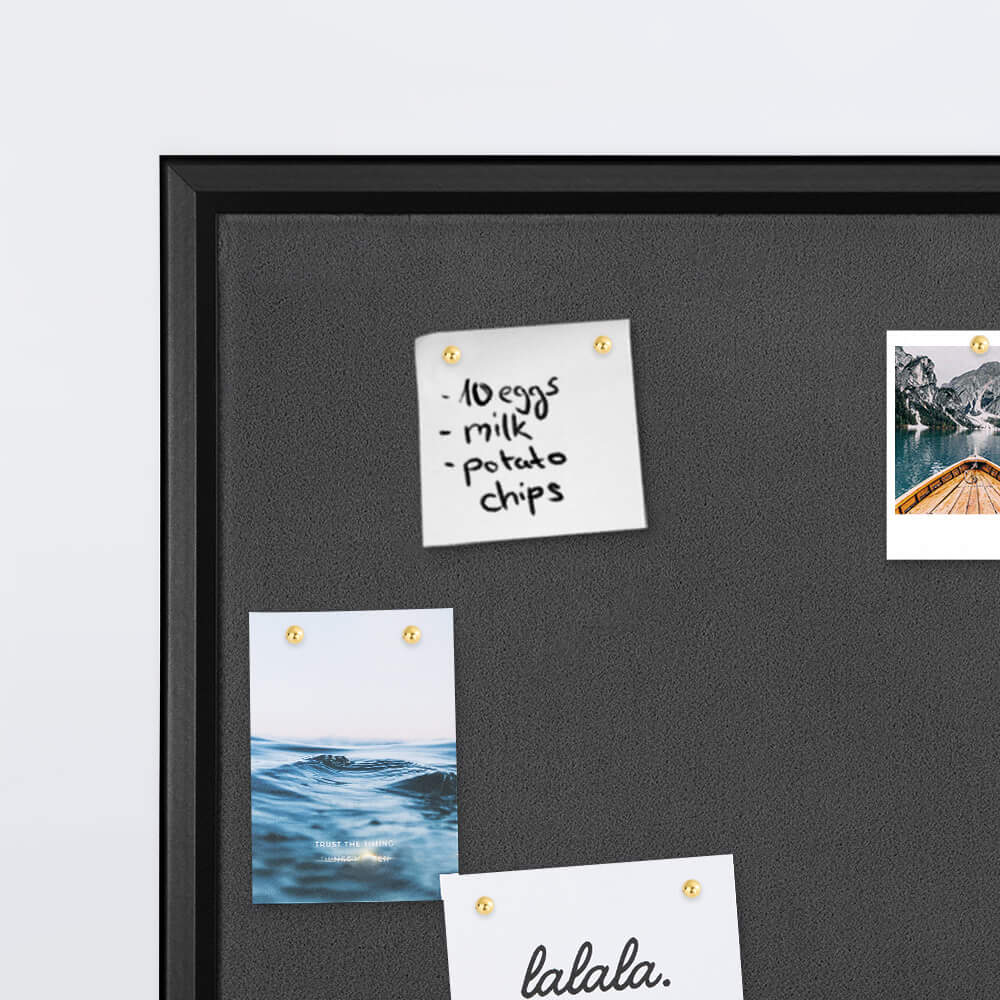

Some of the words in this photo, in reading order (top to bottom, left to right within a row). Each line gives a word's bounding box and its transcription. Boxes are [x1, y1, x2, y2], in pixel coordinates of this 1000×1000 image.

[459, 378, 494, 407] 10
[498, 376, 560, 421] eggs
[463, 411, 533, 445] milk
[463, 445, 568, 487] potato
[479, 480, 565, 516] chips
[520, 936, 671, 1000] lalala.
